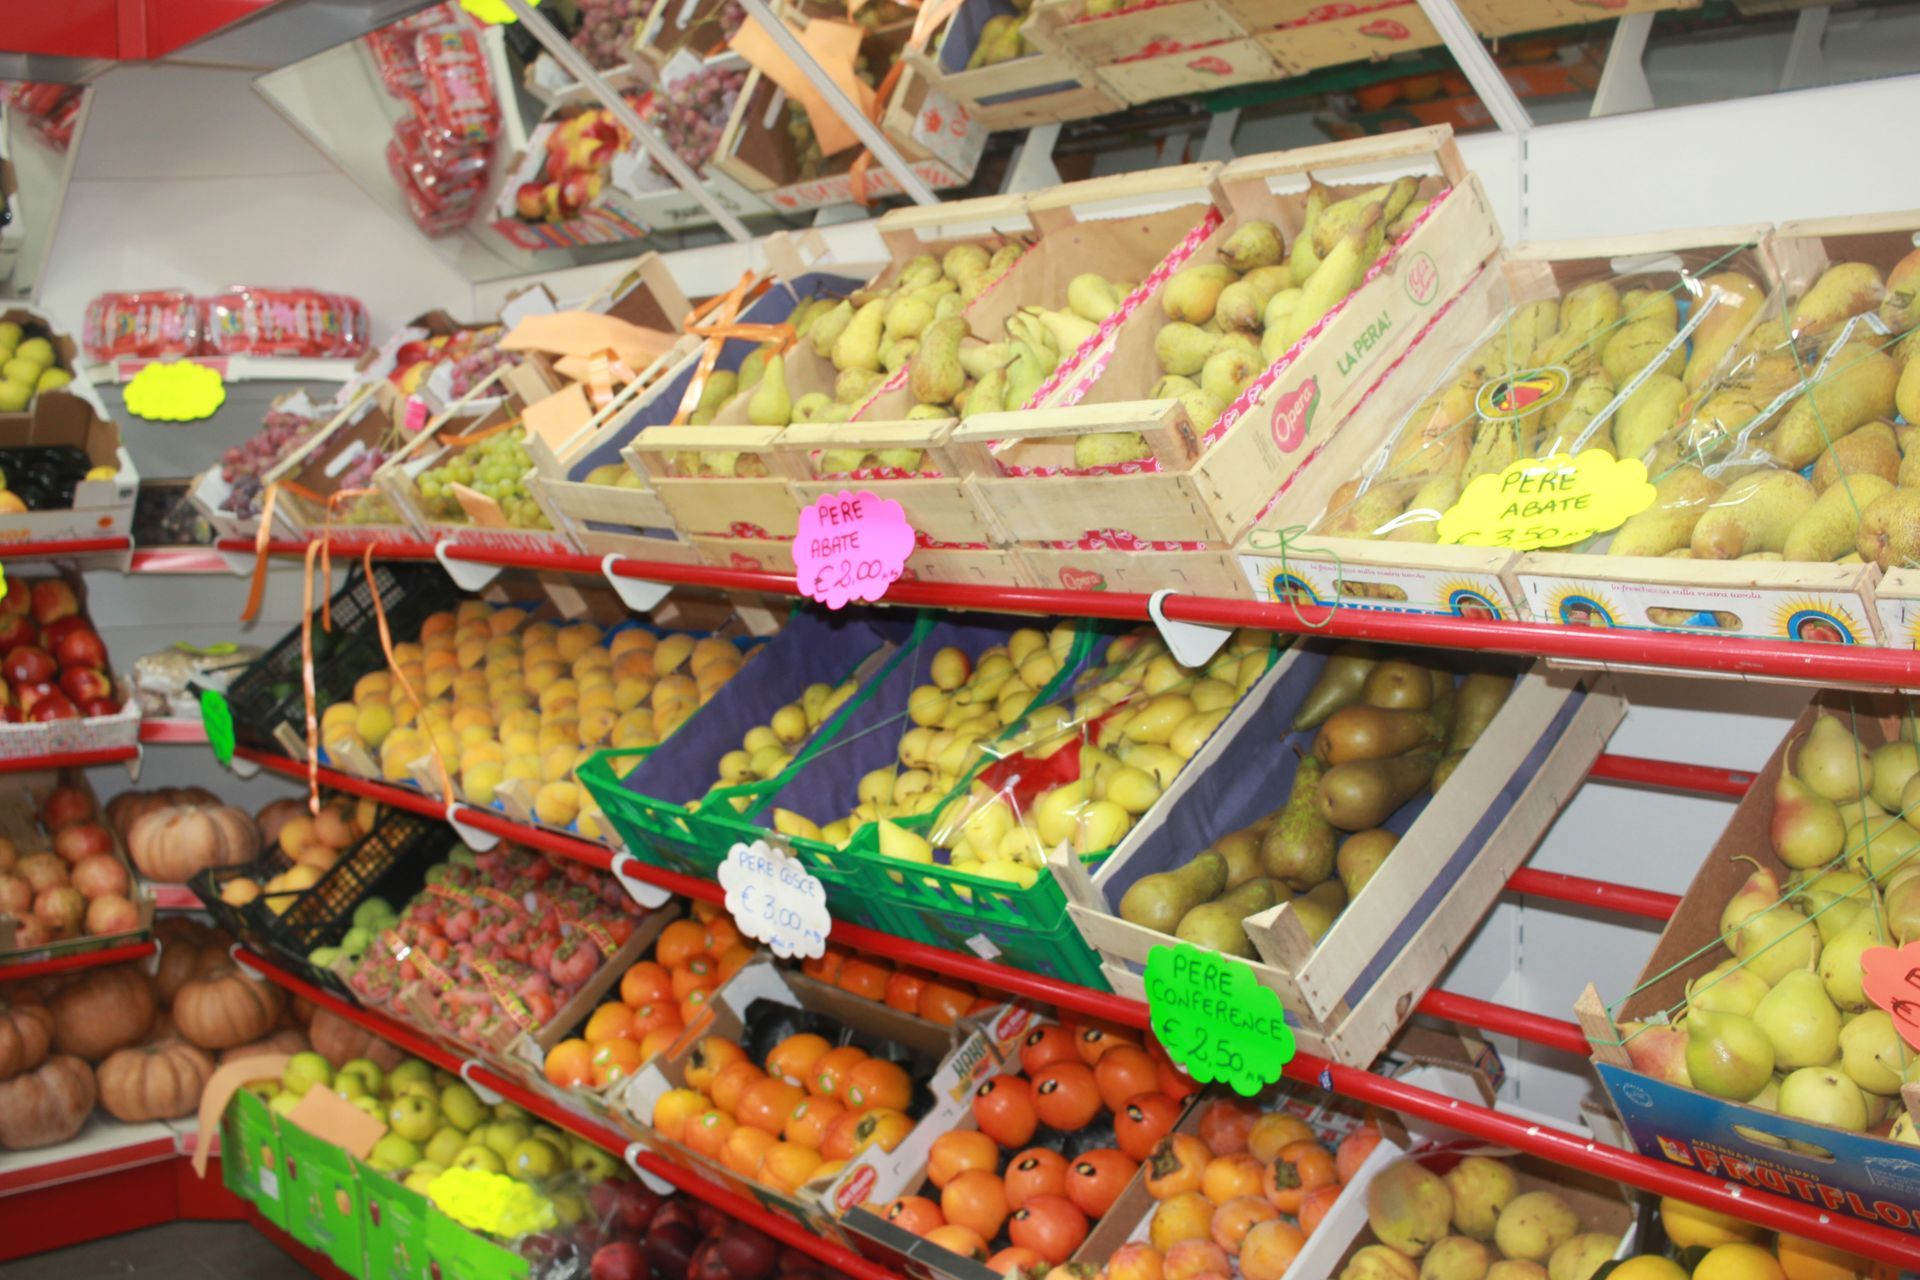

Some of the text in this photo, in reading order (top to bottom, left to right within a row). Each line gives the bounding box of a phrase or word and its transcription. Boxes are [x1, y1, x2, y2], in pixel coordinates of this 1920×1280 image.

[1336, 310, 1392, 377] LA PERA!
[1275, 386, 1313, 442] Opera
[1500, 468, 1580, 494] PERE
[818, 500, 863, 526] PERE
[1499, 493, 1592, 520] ABATE
[811, 531, 859, 559] ABATE
[813, 565, 834, 593] €
[739, 851, 774, 877] PERE
[1174, 954, 1232, 997] PERE
[1152, 978, 1283, 1041] CONFERENCE
[1163, 1018, 1181, 1047] €
[1692, 1146, 1920, 1232] FRUTFLO
